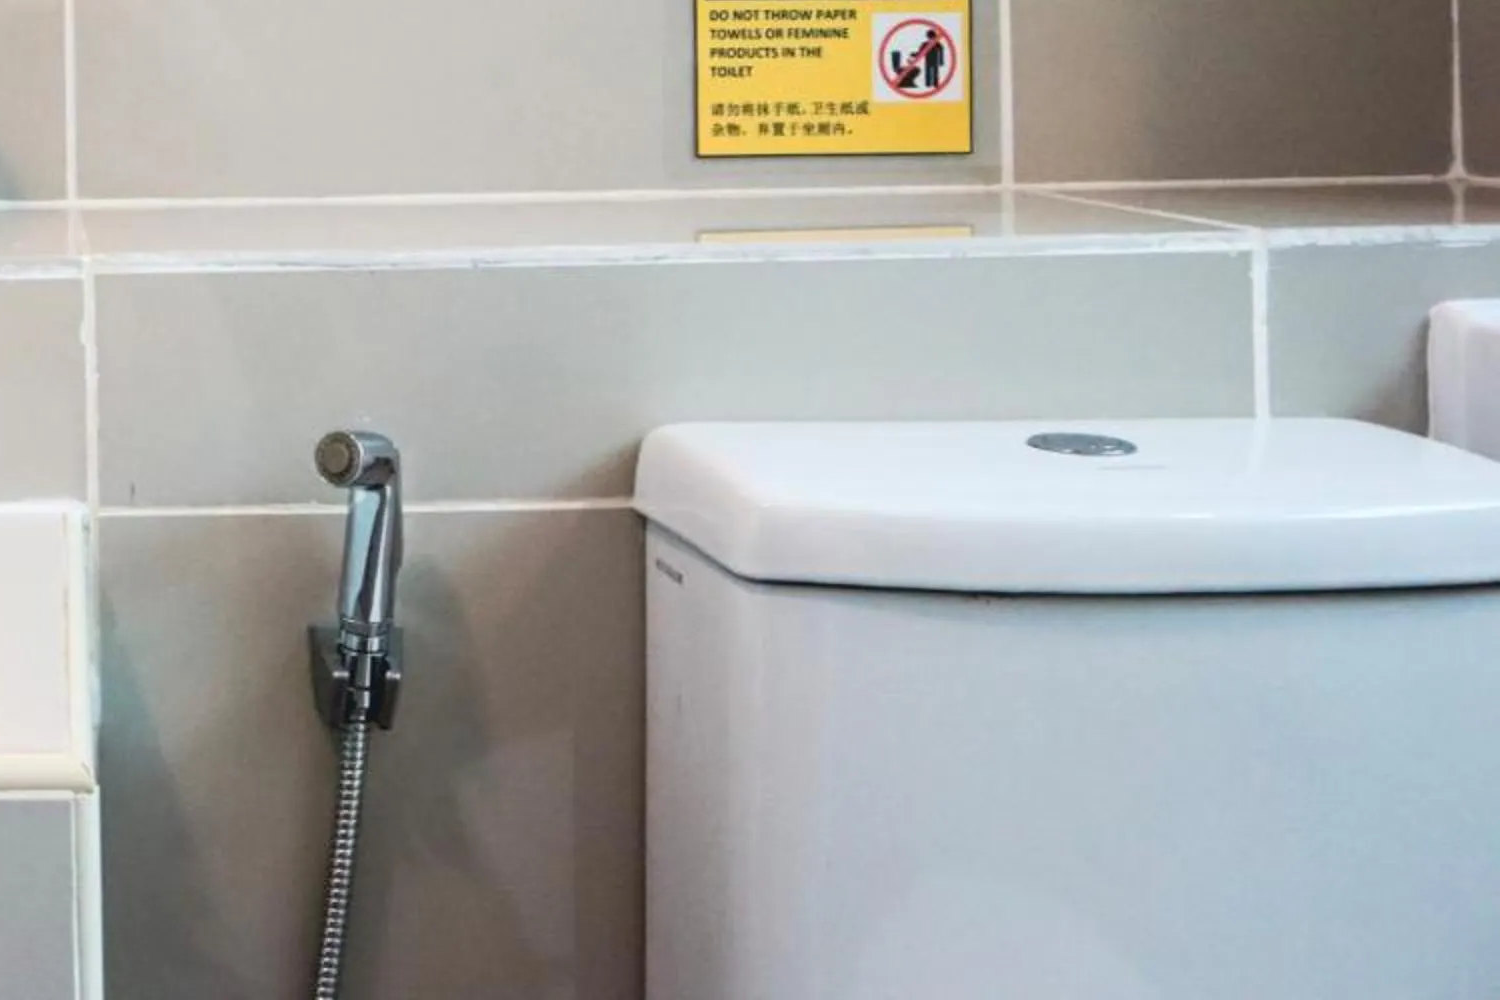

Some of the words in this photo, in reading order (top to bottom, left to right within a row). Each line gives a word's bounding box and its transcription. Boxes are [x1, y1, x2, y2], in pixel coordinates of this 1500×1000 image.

[709, 10, 729, 21] DO
[732, 10, 759, 21] NOT
[764, 9, 812, 21] THROW
[815, 9, 857, 20] PAPER
[710, 28, 762, 39] TOWELS
[765, 28, 783, 39] OR
[787, 27, 849, 39] FEMININE
[710, 47, 778, 59] PRODUCTS
[781, 47, 796, 58] IN
[800, 47, 822, 58] THE
[710, 66, 753, 78] TOILET
